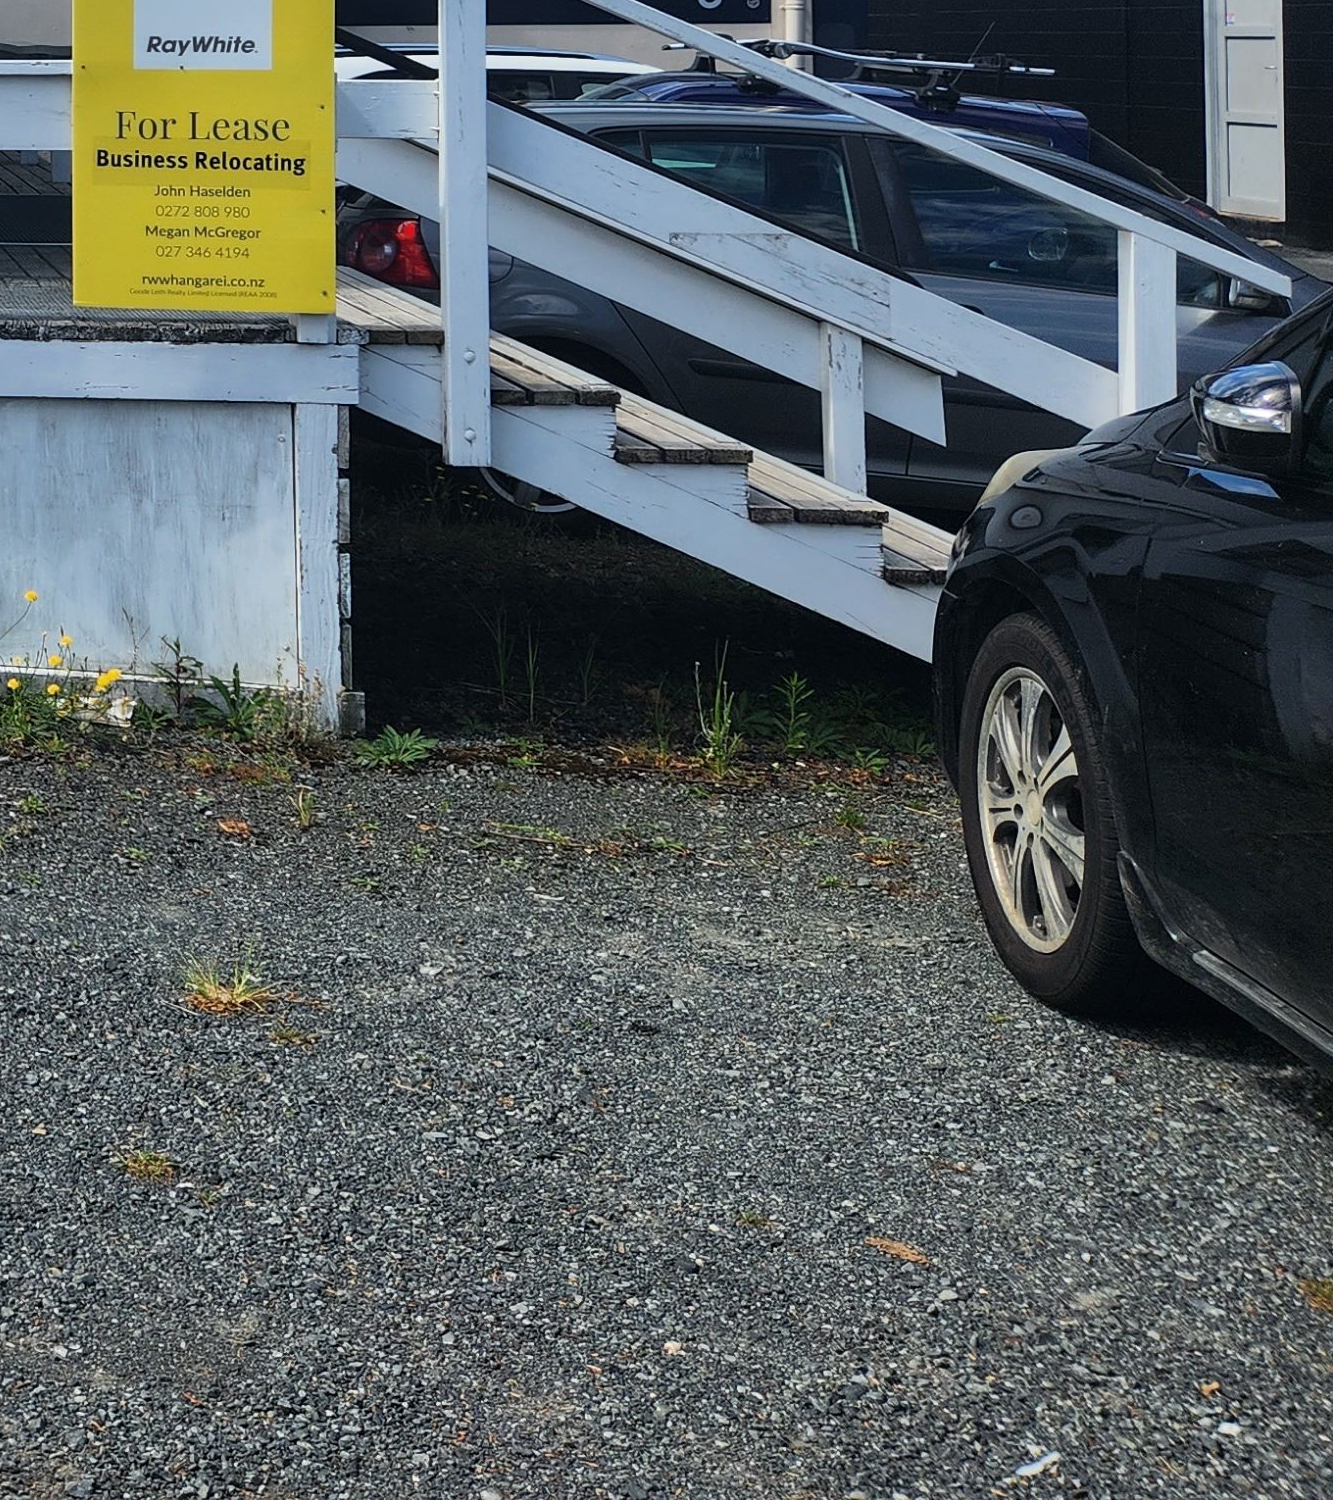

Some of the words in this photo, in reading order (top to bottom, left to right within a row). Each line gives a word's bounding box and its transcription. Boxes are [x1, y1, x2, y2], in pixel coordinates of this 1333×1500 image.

[115, 111, 177, 140] For
[188, 111, 290, 141] Lease
[96, 149, 188, 169] Business
[195, 151, 306, 176] Relocating
[154, 185, 185, 197] John
[190, 185, 251, 197] Haselden
[155, 205, 190, 217] 0272
[194, 206, 220, 218] 808
[223, 206, 251, 218] 980
[145, 225, 190, 239] Megan
[194, 226, 262, 240] McGregor
[155, 245, 182, 257] 027
[185, 246, 211, 258] 346
[215, 247, 250, 258] 4194
[142, 274, 265, 288] rwwhangarei.co.nz
